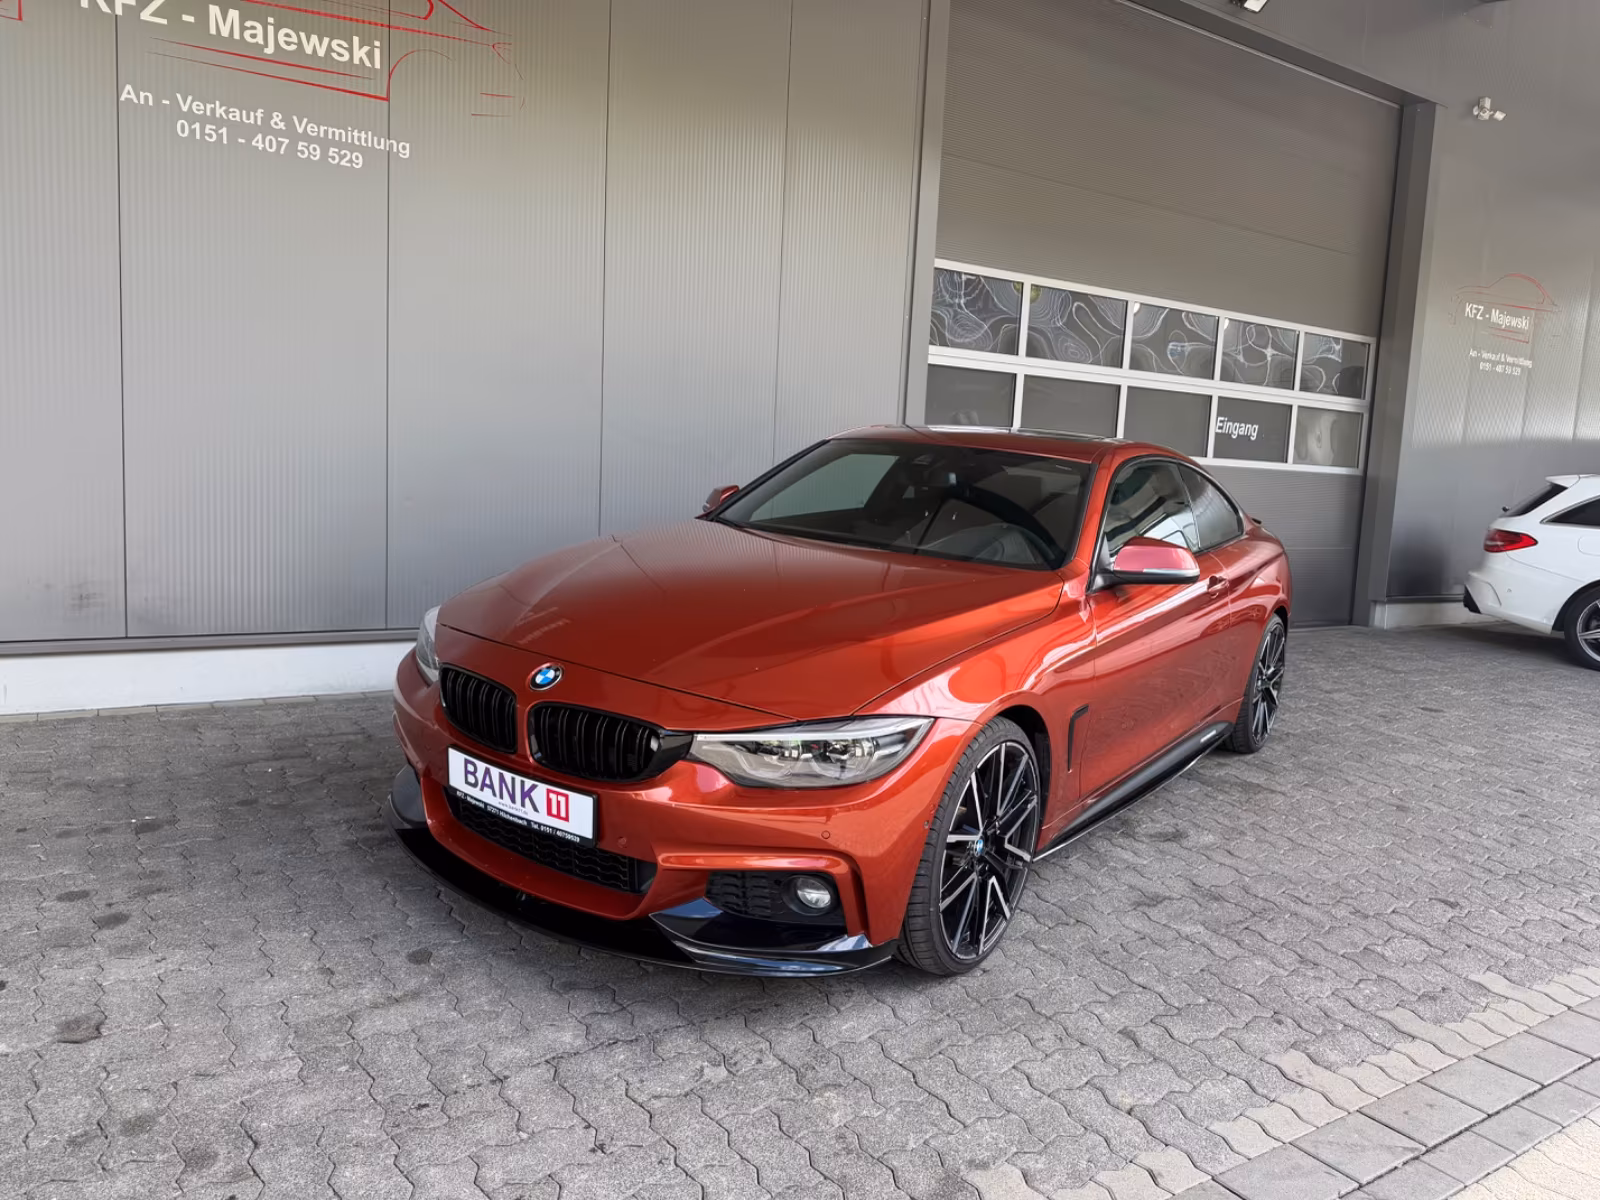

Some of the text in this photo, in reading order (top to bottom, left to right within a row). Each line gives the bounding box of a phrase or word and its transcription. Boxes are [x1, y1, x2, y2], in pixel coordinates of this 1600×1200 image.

[182, 14, 195, 23] -
[208, 4, 381, 69] Majewski
[120, 84, 153, 106] An
[176, 92, 264, 126] Verkauf
[270, 111, 286, 130] &
[292, 115, 410, 159] Vermittlung
[176, 119, 228, 145] 0151
[251, 133, 290, 155] 407
[297, 141, 321, 161] 59
[328, 147, 363, 169] 529
[1465, 302, 1484, 320] KFZ
[1491, 308, 1530, 330] Majewski
[1215, 416, 1259, 441] Eingang
[464, 758, 568, 820] BANK 11
